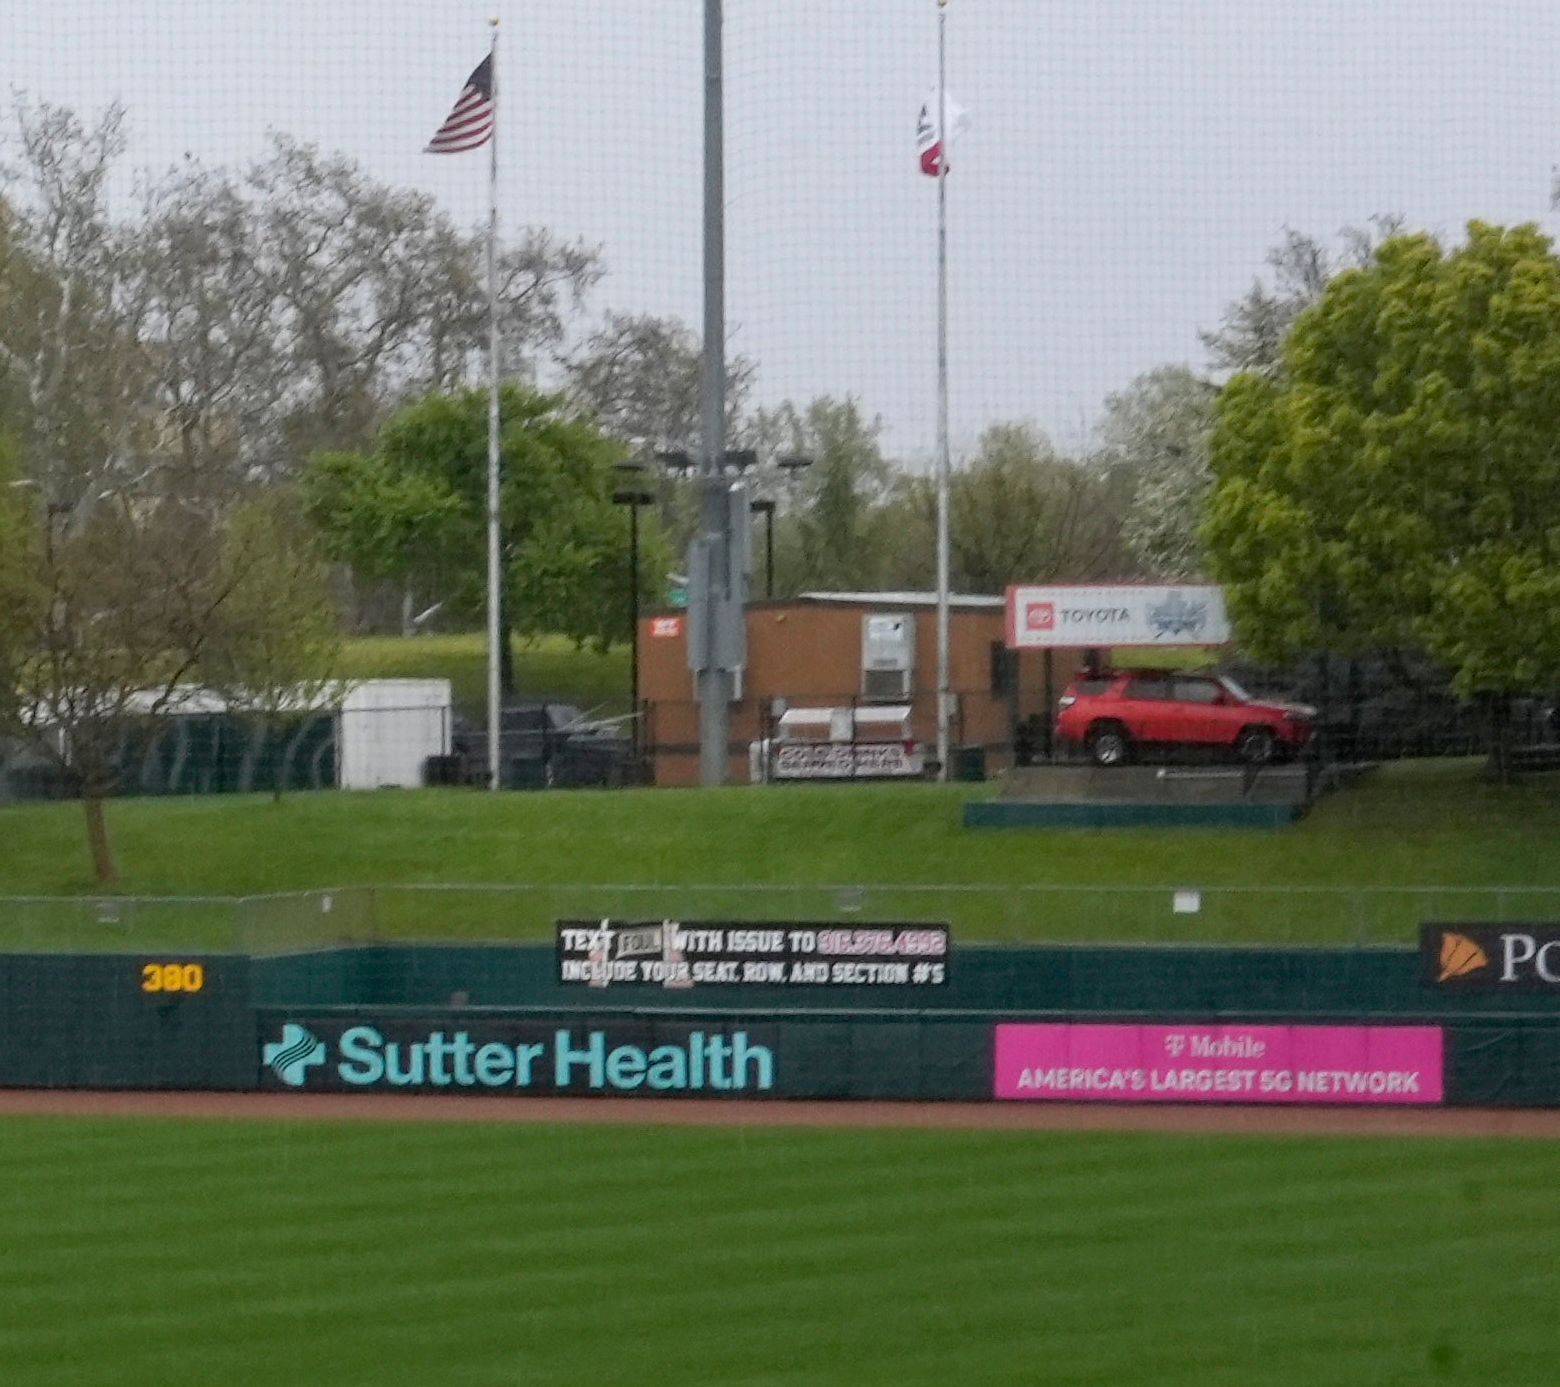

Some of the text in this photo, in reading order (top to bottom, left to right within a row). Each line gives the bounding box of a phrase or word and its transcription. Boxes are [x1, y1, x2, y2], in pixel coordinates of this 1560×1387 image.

[1061, 608, 1130, 624] TOYOTA
[560, 929, 615, 952] TEXT
[672, 929, 723, 952] WITH
[727, 929, 785, 952] ISSUE
[788, 930, 816, 953] TO
[142, 964, 203, 993] 380
[561, 961, 638, 982] INCLUDE
[640, 961, 690, 982] YOUR
[789, 962, 829, 984] AND
[832, 962, 909, 984] SECTION
[338, 1025, 772, 1090] Sutter Health
[1190, 1034, 1266, 1059] Mobile
[1016, 1066, 1420, 1094] AMERICA'S LARGEST 5G NETWORK
